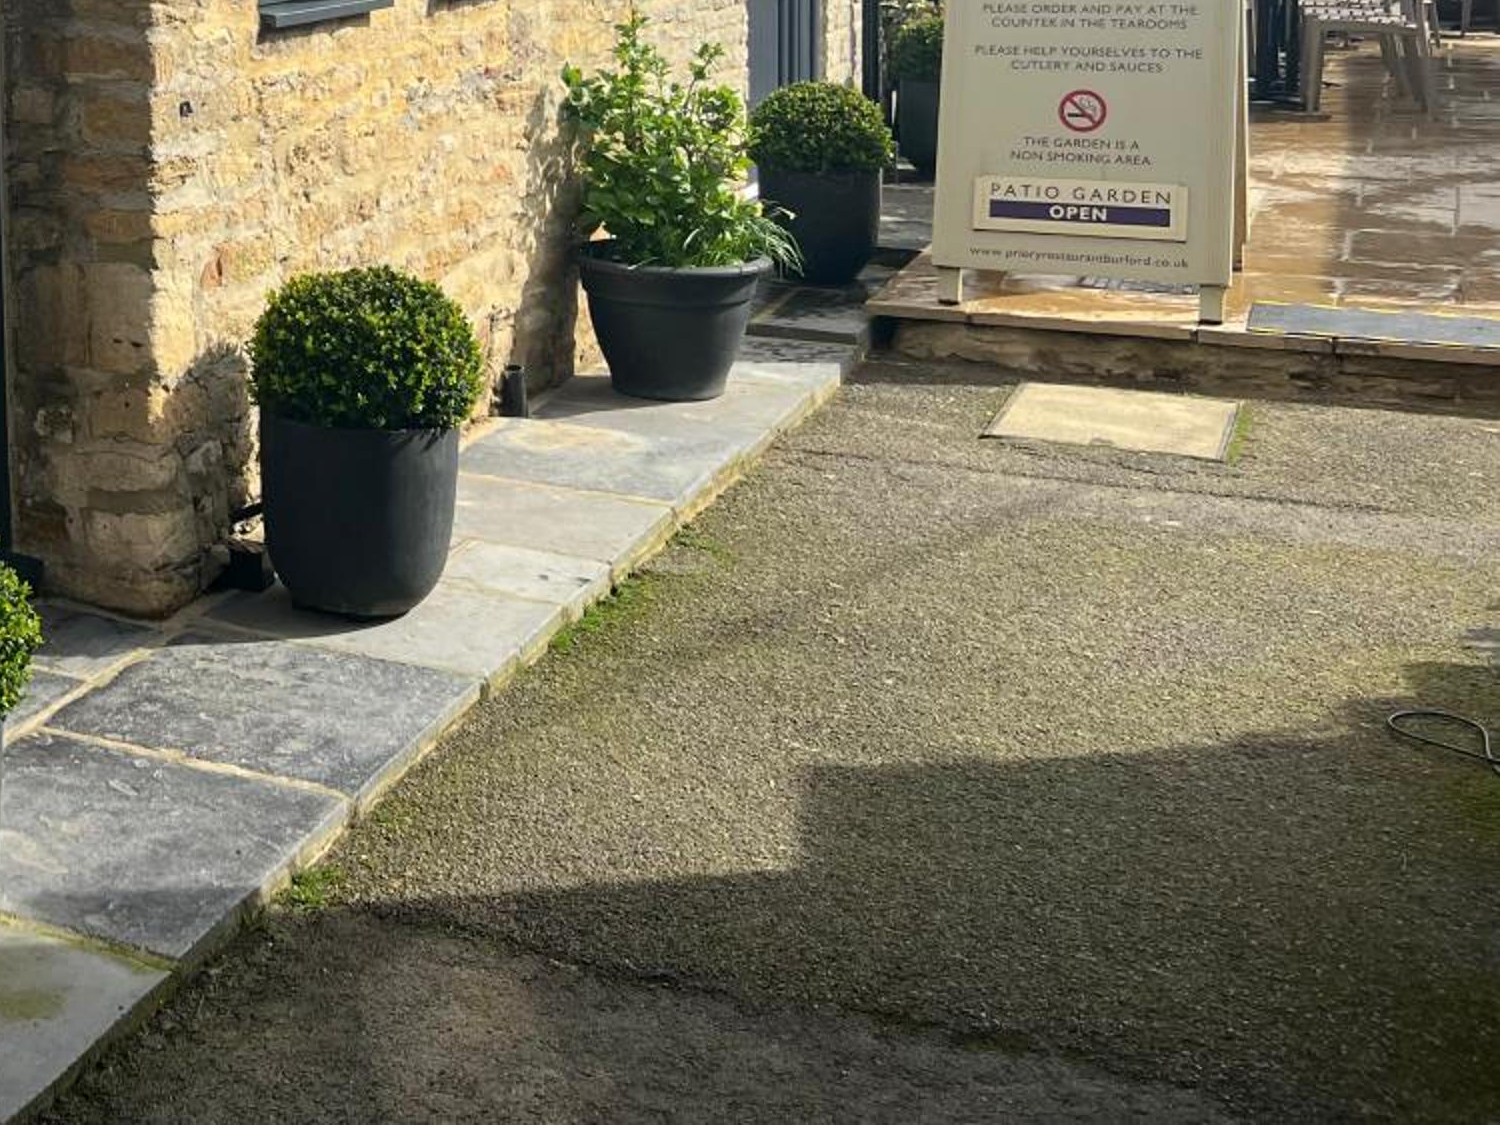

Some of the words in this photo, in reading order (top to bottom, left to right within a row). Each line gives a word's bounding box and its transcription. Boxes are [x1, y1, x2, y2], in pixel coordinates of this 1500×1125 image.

[982, 3, 1027, 15] PLEASE
[1031, 3, 1077, 15] ORDER
[1081, 4, 1111, 15] AND
[1115, 4, 1141, 16] PAY
[1147, 4, 1166, 16] AT
[1171, 4, 1199, 17] THE
[990, 17, 1058, 29] COUNTER
[1061, 18, 1075, 29] IN
[1080, 18, 1105, 29] THE
[1111, 18, 1188, 30] TEAROOMS
[974, 44, 1022, 56] PLEASE
[1024, 45, 1057, 57] HELP
[1061, 46, 1146, 58] YOURSELVES
[1151, 47, 1171, 59] TO
[1175, 48, 1204, 60] THE
[1011, 59, 1070, 71] CUTLERY
[1075, 61, 1106, 72] AND
[1109, 62, 1164, 74] SAUCES
[1023, 136, 1049, 147] THE
[1053, 138, 1111, 150] GARDEN
[1116, 140, 1126, 151] IS
[1129, 140, 1140, 151] A
[1010, 150, 1043, 162] NON
[1046, 151, 1111, 164] SMOKING
[1114, 154, 1152, 166] AREA
[990, 181, 1060, 199] PATIO
[1072, 186, 1171, 205] GARDEN
[1049, 205, 1108, 222] OPEN
